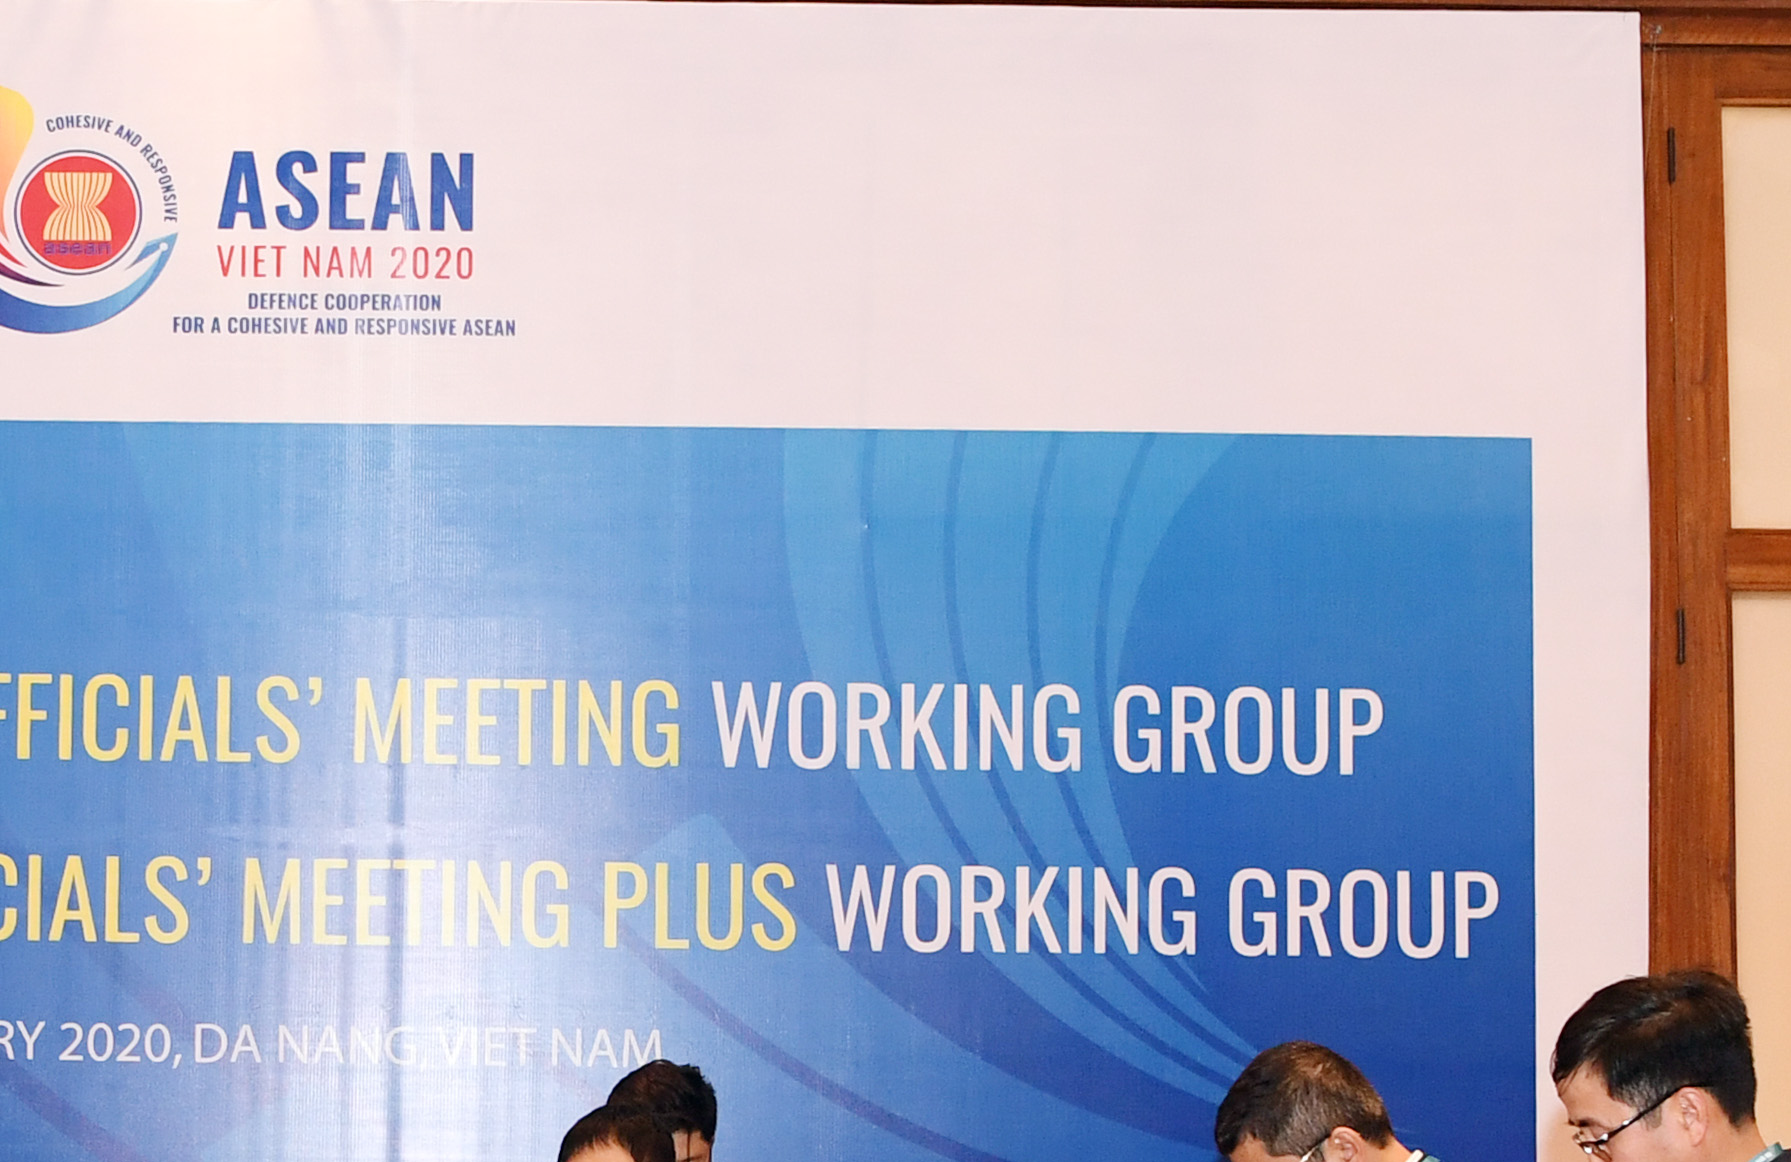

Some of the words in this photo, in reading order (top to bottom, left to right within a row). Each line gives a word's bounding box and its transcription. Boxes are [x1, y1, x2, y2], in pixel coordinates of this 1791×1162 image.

[46, 115, 114, 133] COHESIVE
[114, 124, 143, 148] AND
[140, 143, 179, 222] RESPONSIVE
[217, 150, 474, 231] ASEAN
[44, 241, 112, 255] asean
[216, 245, 287, 278] VIET
[303, 245, 372, 278] NAM
[390, 246, 473, 279] 2020
[248, 292, 319, 311] DEFENCE
[324, 293, 442, 311] COOPERATION
[172, 316, 205, 334] FOR
[211, 316, 221, 334] A
[227, 316, 308, 335] COHESIVE
[314, 317, 348, 335] AND
[355, 317, 457, 336] RESPONSIVE
[463, 319, 516, 336] ASEAN
[354, 676, 681, 769] MEETING
[712, 680, 1082, 773] WORKING
[1113, 684, 1384, 776] GROUP
[242, 856, 571, 949] MEETING
[604, 861, 797, 951] PLUS
[826, 862, 1198, 956] WORKING
[1228, 867, 1500, 960] GROUP
[58, 1022, 183, 1069] 2020,
[194, 1023, 262, 1064] DA
[431, 1027, 537, 1067] VIET
[551, 1028, 663, 1067] NAM
